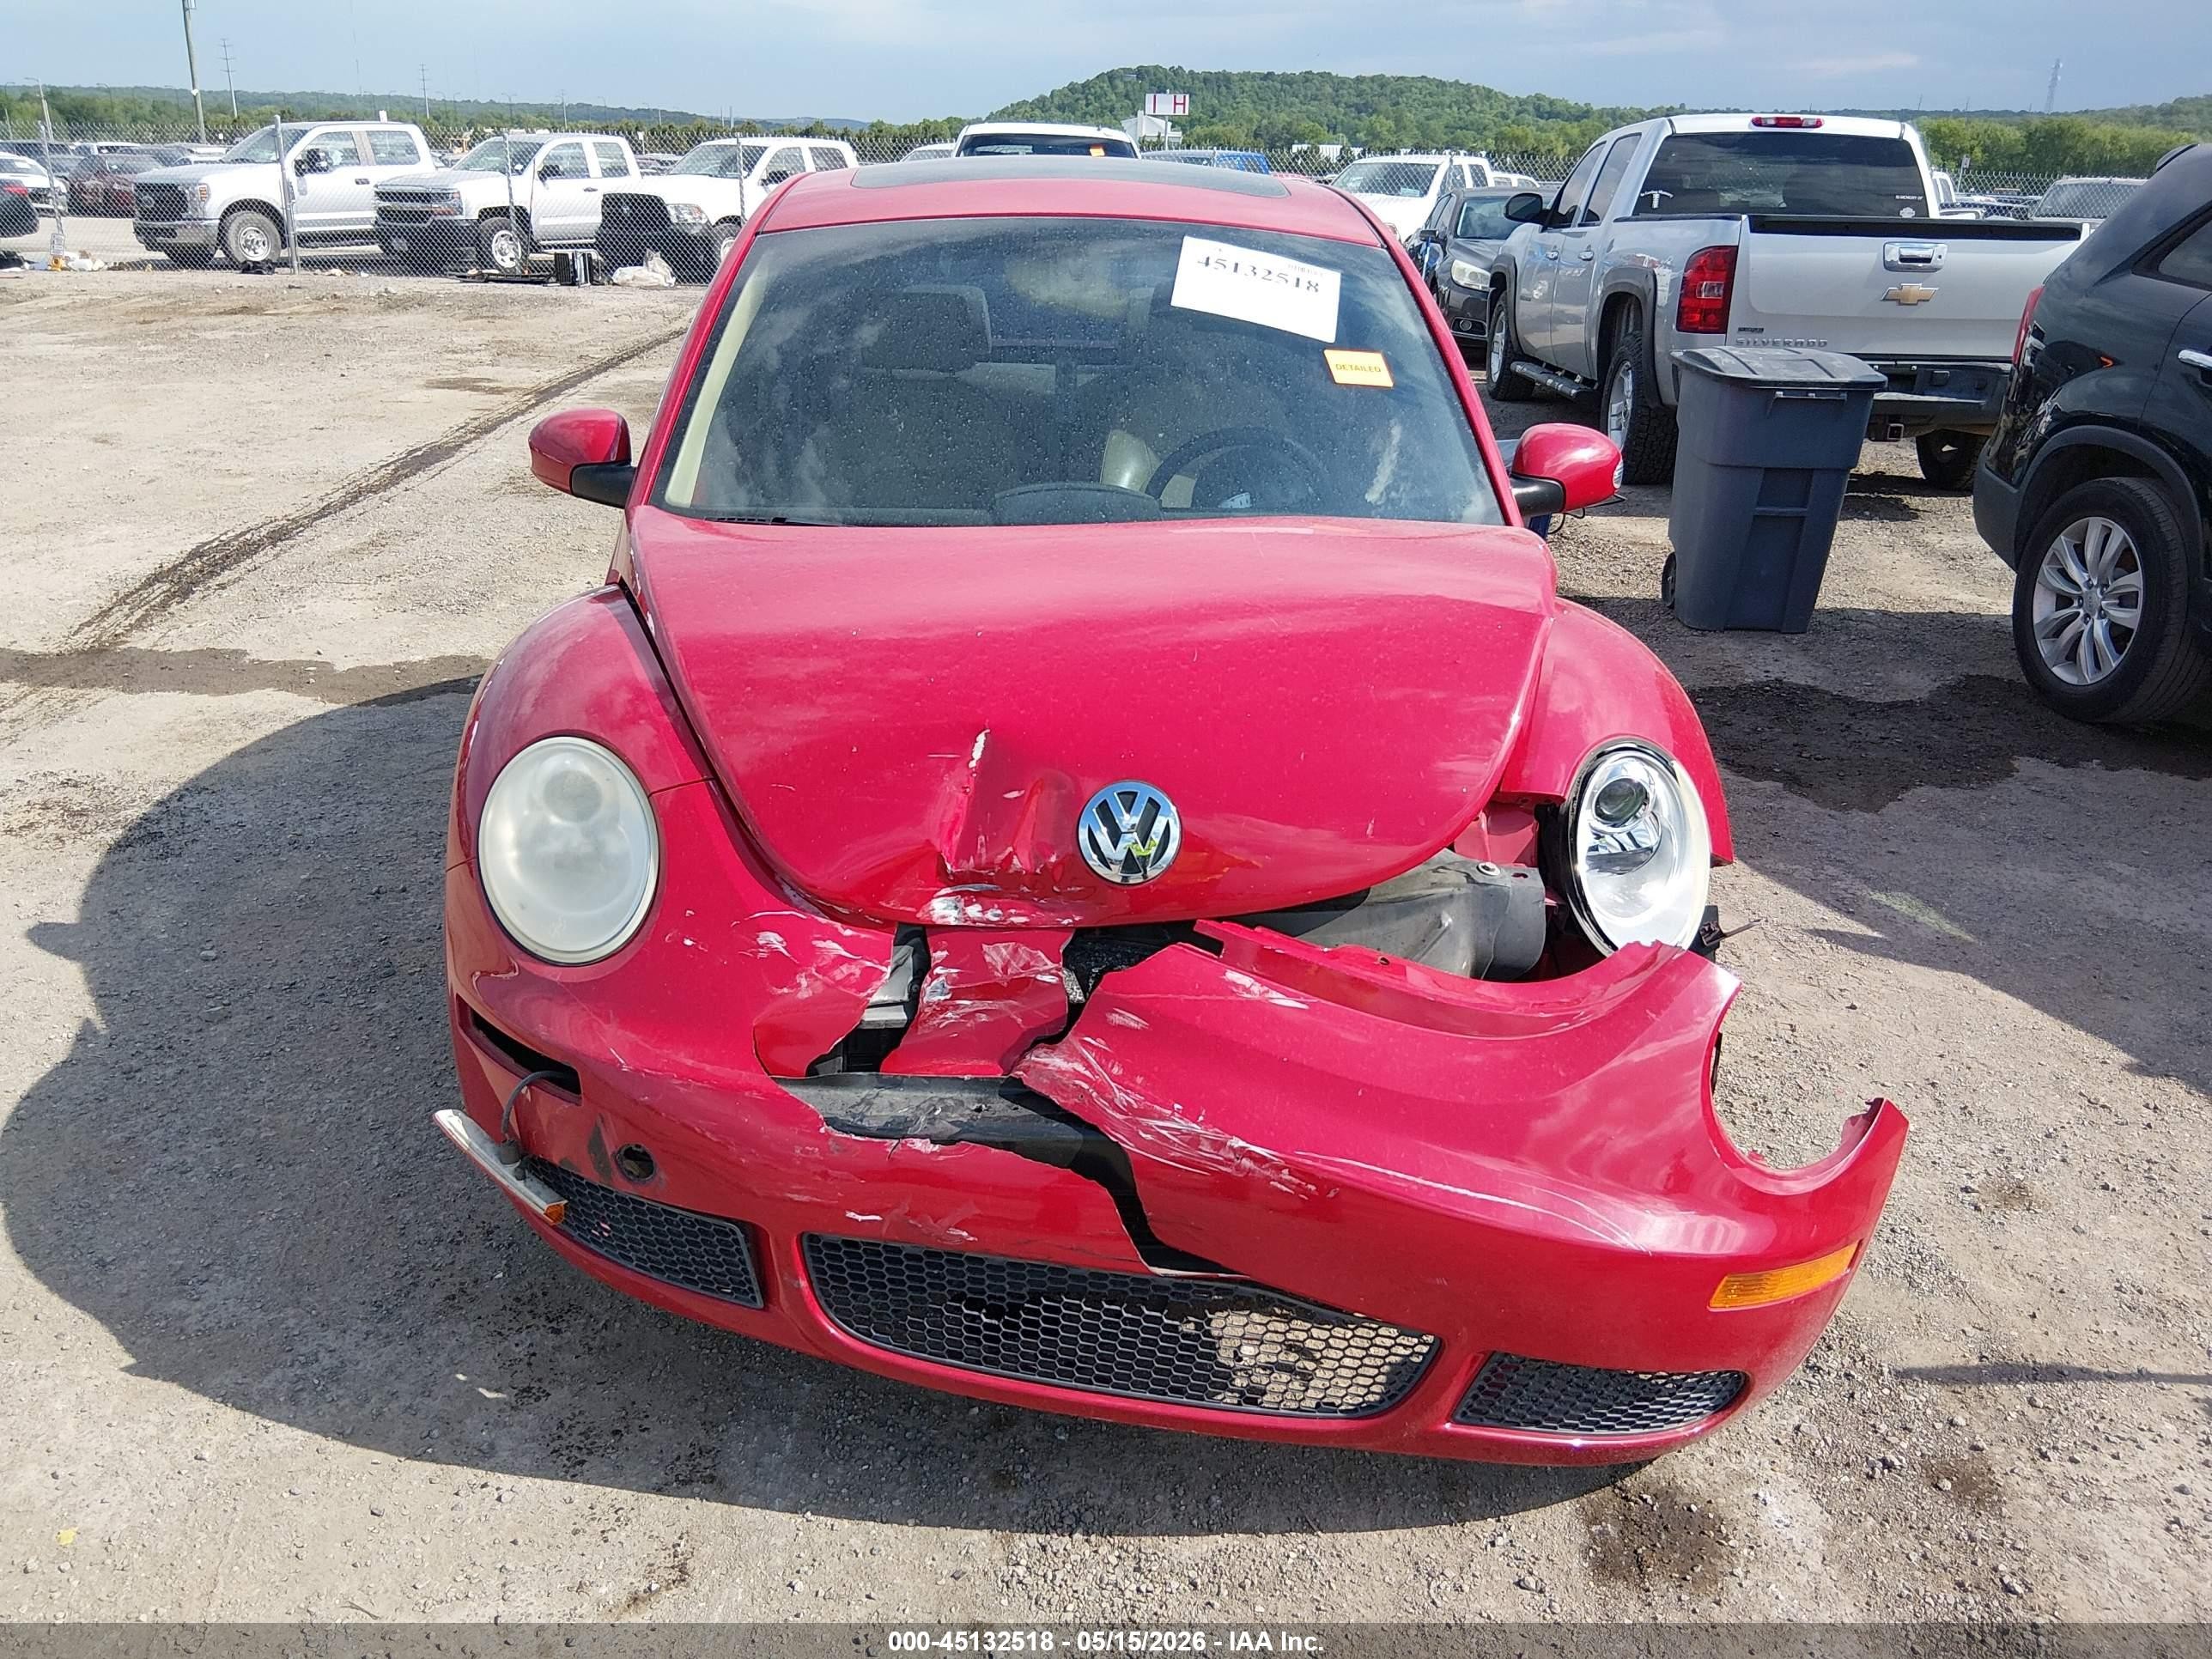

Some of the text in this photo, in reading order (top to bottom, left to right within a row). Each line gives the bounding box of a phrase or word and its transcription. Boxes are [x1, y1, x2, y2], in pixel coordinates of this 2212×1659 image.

[1197, 256, 1320, 293] 45132518
[1735, 337, 1828, 348] SILVERADO
[1334, 363, 1382, 373] DETAILED
